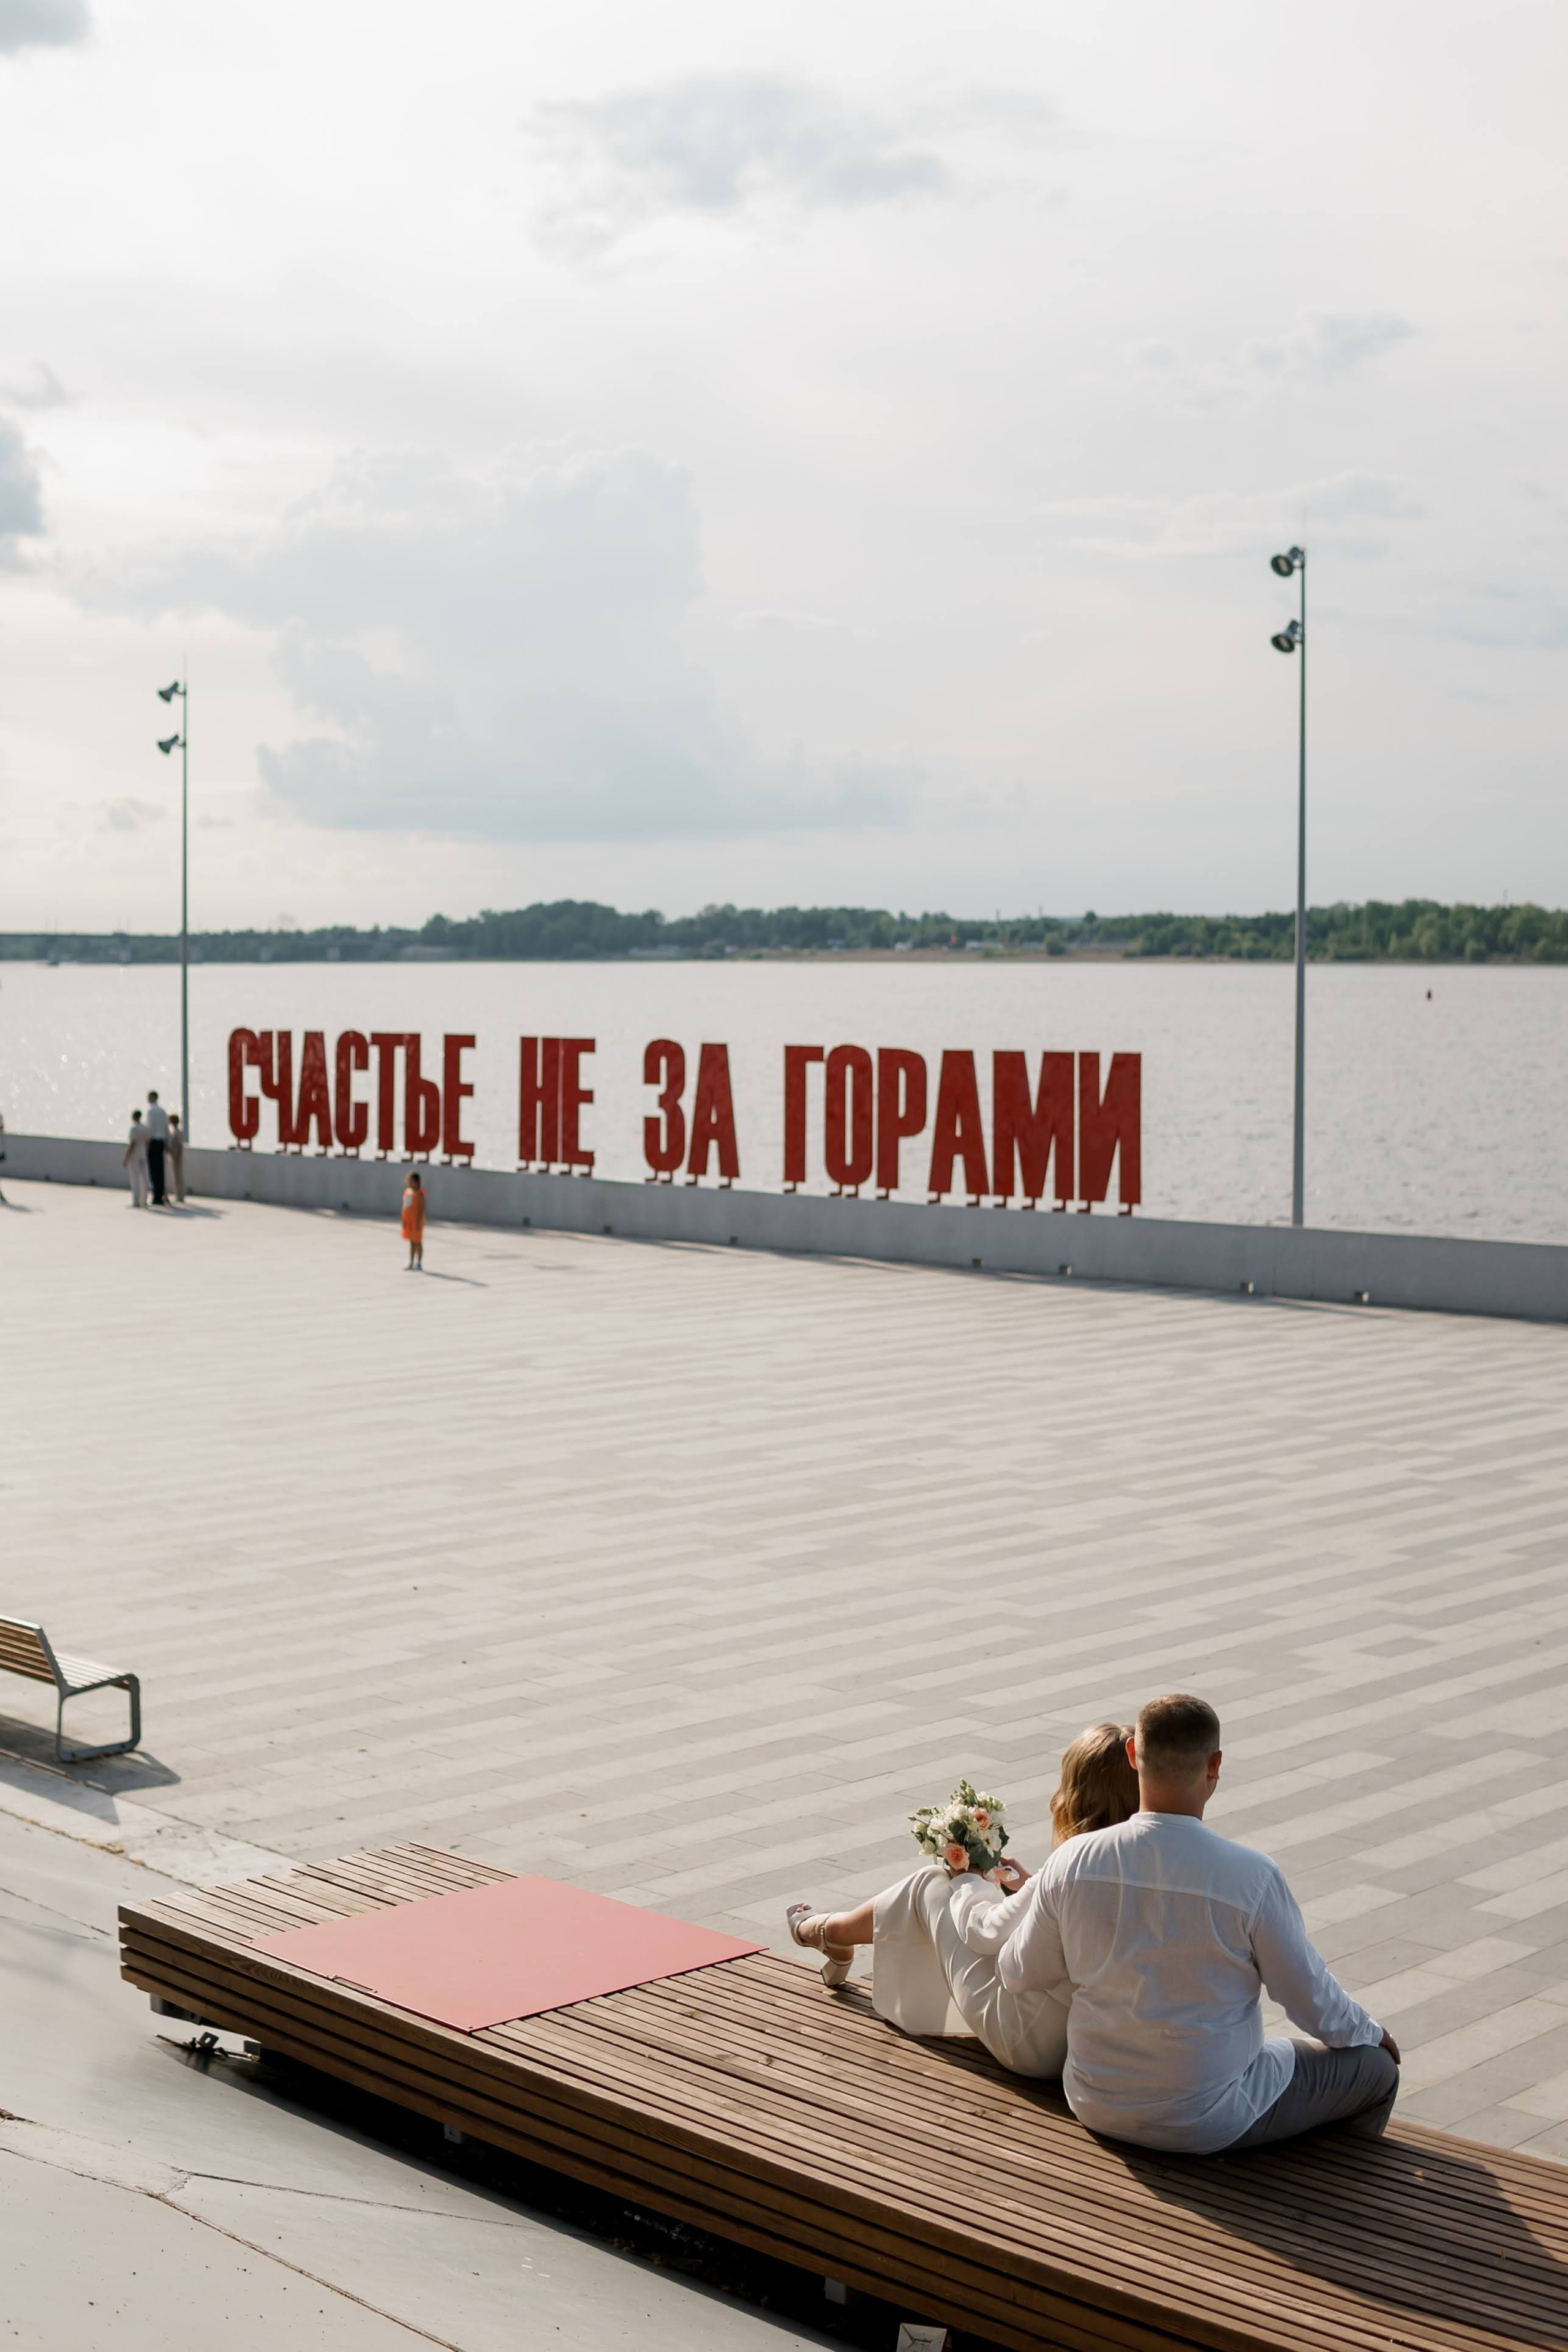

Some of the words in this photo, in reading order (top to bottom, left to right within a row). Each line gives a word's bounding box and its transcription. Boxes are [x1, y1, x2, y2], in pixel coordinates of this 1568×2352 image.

[228, 1028, 475, 1156] СЧАСТЬЕ
[519, 1037, 596, 1166] НЕ
[644, 1039, 739, 1178] ЗА
[784, 1044, 1141, 1205] ГОРАМИ
